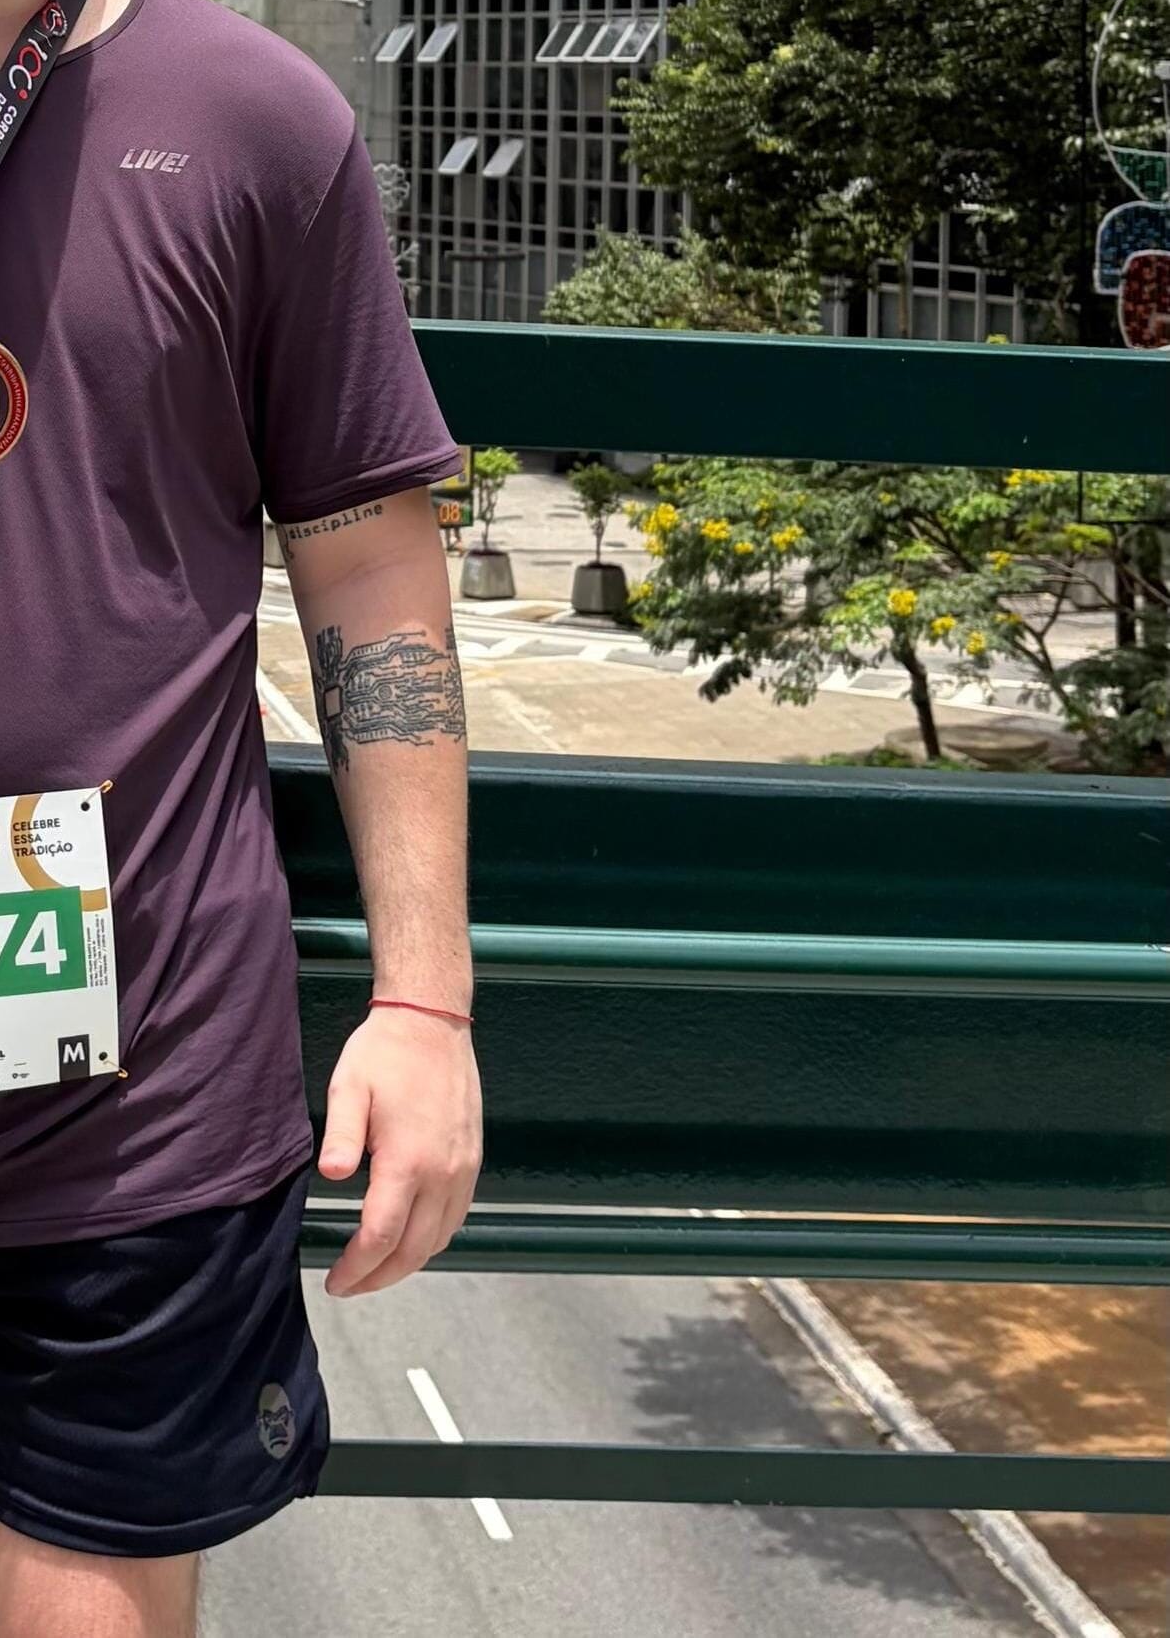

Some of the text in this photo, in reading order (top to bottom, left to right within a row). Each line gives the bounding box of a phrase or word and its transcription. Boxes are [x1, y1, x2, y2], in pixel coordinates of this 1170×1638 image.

[119, 148, 191, 174] LIVE!
[12, 817, 61, 832] CELEBRE
[13, 833, 43, 845] ESSA
[13, 840, 73, 859] TRADIÇÃO
[62, 1042, 86, 1064] M
